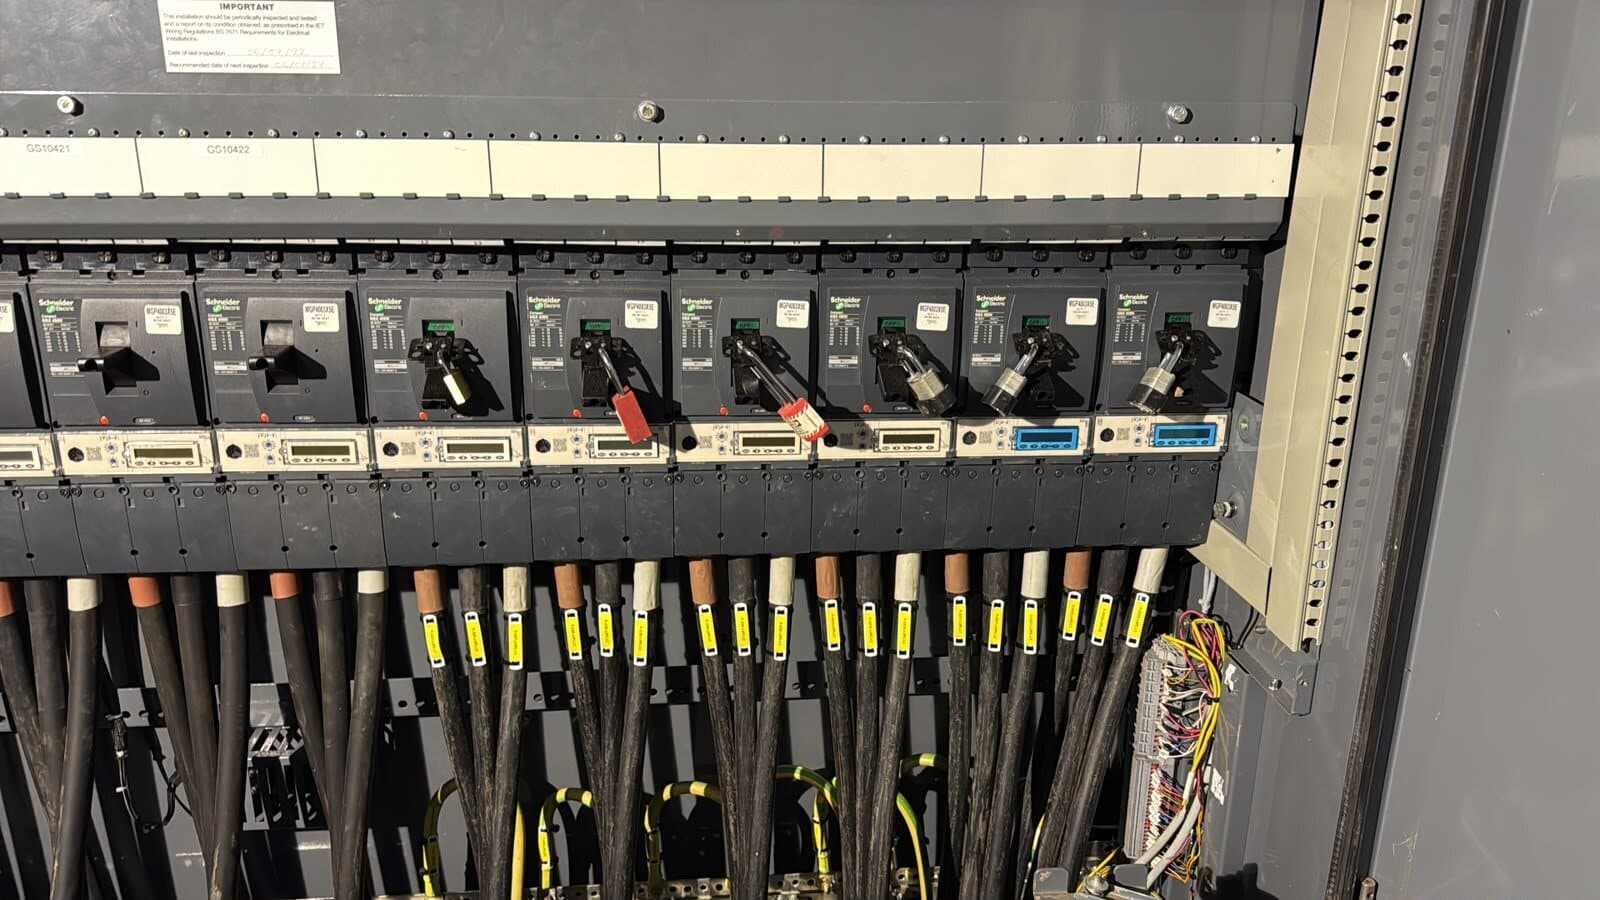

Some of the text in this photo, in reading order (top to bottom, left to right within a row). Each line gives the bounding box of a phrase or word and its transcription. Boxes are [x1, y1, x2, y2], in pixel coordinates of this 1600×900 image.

[219, 3, 275, 11] IMPORTANT
[26, 143, 70, 152] GS10421
[207, 145, 250, 154] GS10422
[206, 298, 240, 306] Schneider
[368, 297, 402, 306] Schneider
[528, 296, 561, 304] Schneider
[681, 297, 712, 305] Schneider
[830, 296, 861, 304] Schneider
[1119, 294, 1149, 302] Schneider
[38, 298, 74, 307] Schneider
